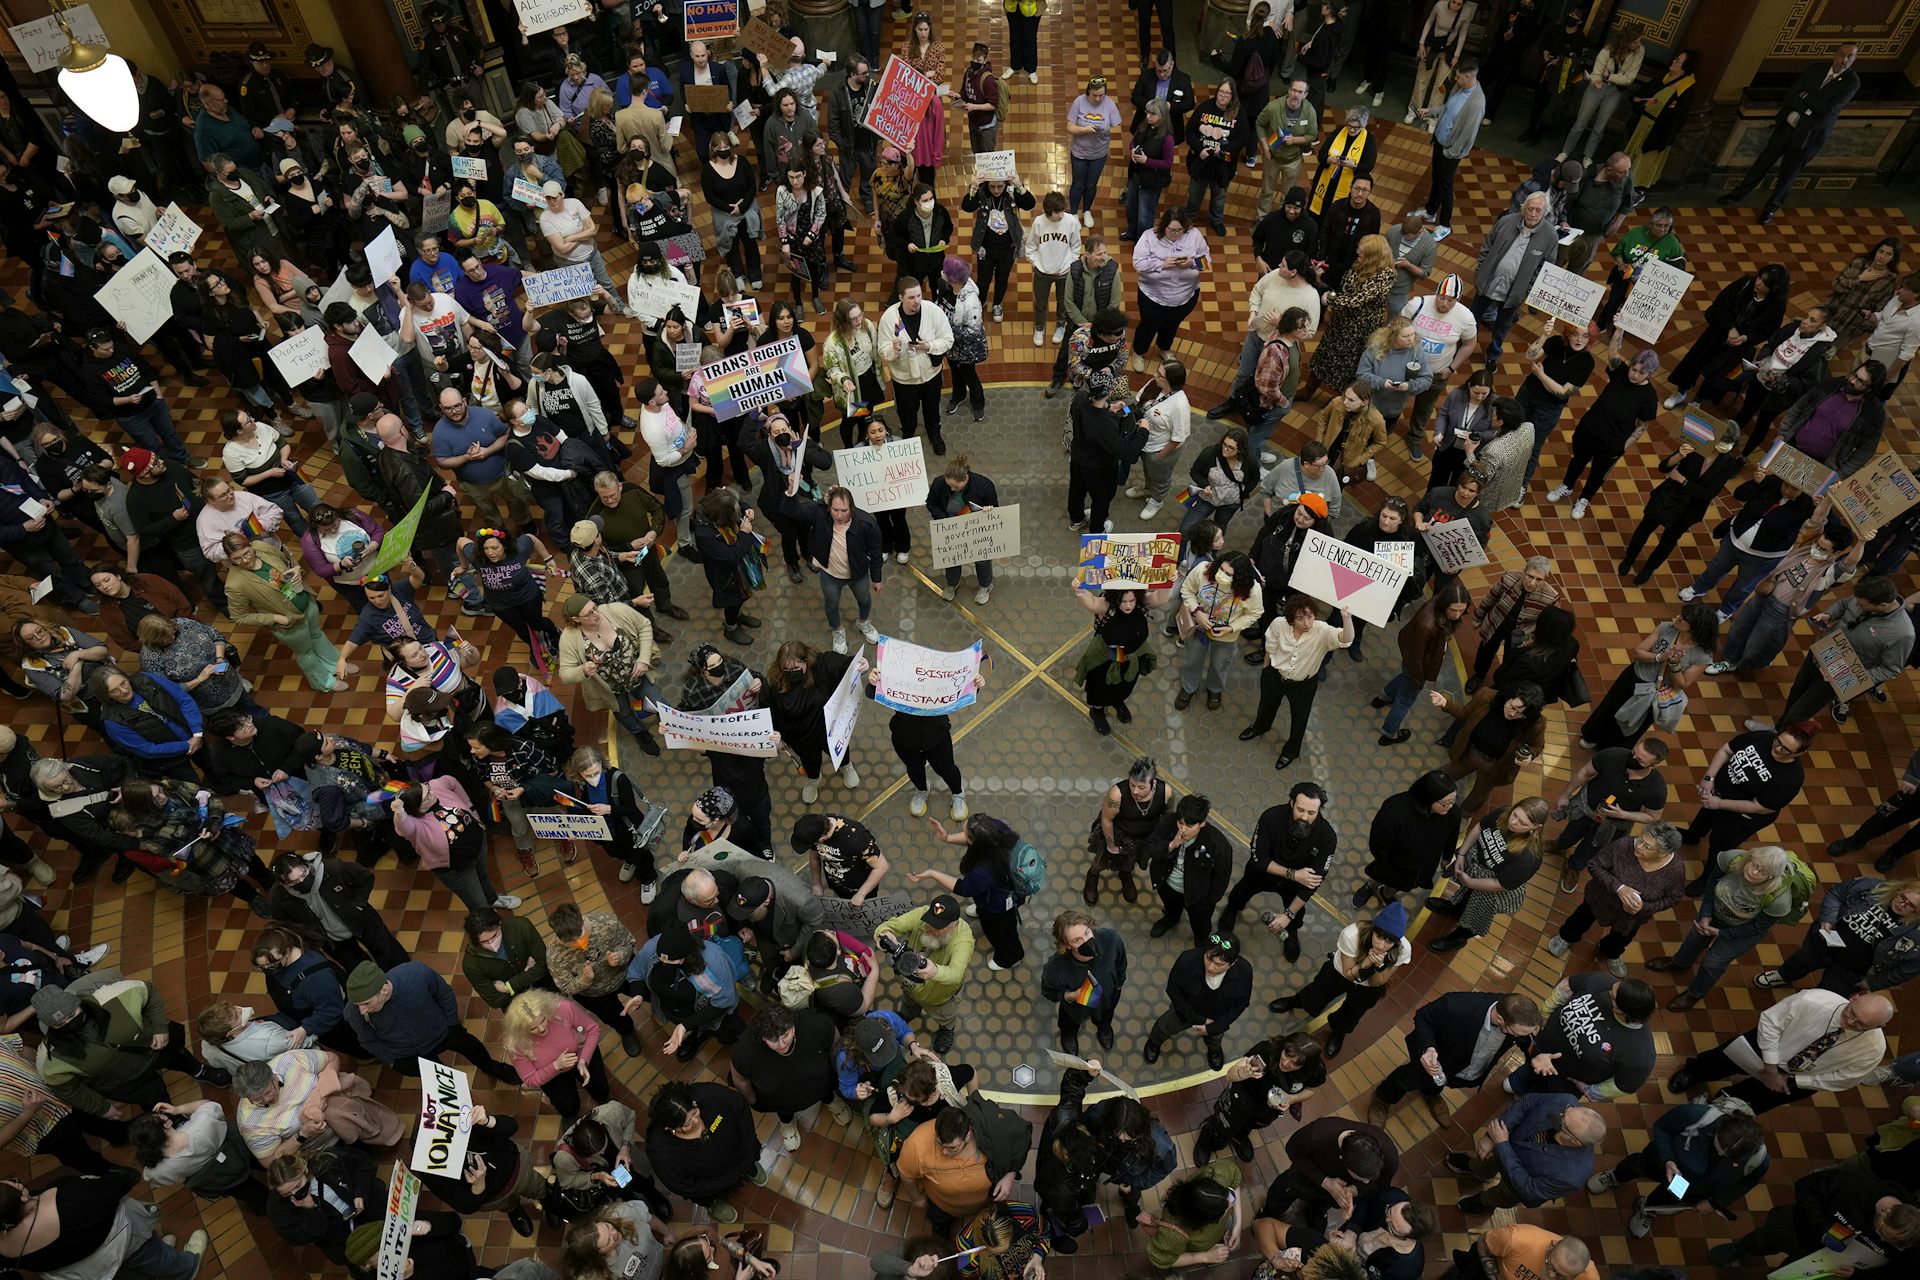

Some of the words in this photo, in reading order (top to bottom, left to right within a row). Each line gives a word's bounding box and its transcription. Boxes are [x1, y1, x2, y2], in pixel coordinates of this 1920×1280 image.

[520, 0, 541, 12] ALL
[687, 6, 704, 16] NO
[707, 3, 737, 14] HATE
[696, 26, 710, 34] OUR
[712, 24, 737, 32] STATE
[894, 63, 930, 97] TRANS
[887, 93, 906, 112] ARE
[890, 77, 925, 111] RIGHTS
[876, 101, 915, 135] HUMAN
[453, 157, 460, 166] NO
[462, 158, 476, 168] HATE
[469, 168, 485, 178] STATE
[641, 223, 657, 231] GENDER
[657, 218, 667, 226] NOT
[1039, 232, 1069, 245] IOWA
[1630, 248, 1659, 260] POWER
[525, 275, 541, 287] OUR
[541, 266, 582, 285] LIBERTIES
[582, 265, 590, 274] WE
[1562, 271, 1580, 285] OUR
[1649, 262, 1679, 285] TRANS
[527, 283, 551, 296] PRIZE
[564, 278, 575, 287] OUR
[679, 293, 695, 302] THEY
[1542, 275, 1590, 303] EXISTENCE
[1639, 275, 1682, 301] EXISTENCE
[1650, 291, 1658, 300] IS
[533, 297, 546, 307] WE
[548, 290, 565, 303] WILL
[1536, 289, 1581, 316] RESISTANCE
[1631, 289, 1660, 309] ROOTED
[1660, 303, 1670, 312] IN
[1631, 298, 1656, 316] HUMAN
[1415, 314, 1453, 336] HERE
[1624, 305, 1654, 325] HISTORY
[270, 336, 310, 362] Protect
[702, 354, 750, 381] TRANS
[753, 339, 798, 363] RIGHTS
[102, 357, 133, 382] HUMAN
[745, 366, 761, 377] ARE
[551, 389, 560, 397] ARE
[729, 370, 786, 400] HUMAN
[544, 403, 570, 412] WAITING
[740, 388, 785, 412] RIGHTS
[839, 450, 884, 468] TRANS
[886, 440, 921, 461] PEOPLE
[844, 471, 879, 489] WILL
[884, 460, 923, 481] ALWAYS
[1869, 471, 1885, 485] WE
[1877, 451, 1895, 472] OUR
[1889, 468, 1920, 501] LIBERTIES
[865, 484, 914, 506] EXIST!!!
[1848, 480, 1869, 507] RIGHTS
[1862, 500, 1875, 512] WE
[932, 519, 960, 535] There
[963, 517, 982, 530] goes
[986, 512, 1000, 523] the
[943, 521, 1005, 546] government
[934, 541, 970, 560] taking
[972, 535, 994, 550] away
[942, 548, 974, 567] rights
[976, 545, 1007, 560] again!
[1149, 539, 1174, 555] PRIZE
[1376, 542, 1392, 552] THIS
[1392, 542, 1399, 551] IS
[1400, 543, 1414, 552] WHY
[1435, 543, 1455, 569] WRONG
[495, 561, 522, 573] TRANS
[1307, 540, 1402, 592] SILENCE=DEATH
[1376, 553, 1406, 568] PRIDE
[482, 571, 512, 584] PEOPLE
[1819, 644, 1857, 694] NEIGHBOR
[1831, 632, 1852, 661] LOVE
[1846, 658, 1869, 685] YOUR
[915, 665, 969, 681] EXISTENCE
[916, 675, 927, 684] or
[886, 686, 962, 707] RESISTANCE!
[661, 704, 703, 724] TRANS
[710, 712, 761, 725] PEOPLE
[667, 732, 756, 751] TRANSPHOBIA
[757, 740, 775, 750] IS
[708, 728, 772, 739] DANGEROUS
[1729, 753, 1749, 783] STUFF
[1735, 749, 1753, 770] GET
[1744, 744, 1772, 783] BITCHES
[529, 815, 564, 825] TRANS
[566, 815, 597, 825] RIGHTS
[536, 829, 570, 839] HUMAN
[572, 828, 605, 840] RIGHTS!
[1492, 828, 1508, 853] QUEER
[1482, 827, 1505, 865] LIBERATION
[839, 908, 865, 920] NOT
[1851, 913, 1884, 938] STUFF
[1562, 1001, 1586, 1036] TAKE
[1579, 993, 1605, 1023] ALLY
[1571, 997, 1601, 1045] MEANS
[435, 1063, 456, 1108] NICE
[423, 1092, 438, 1130] NOT
[427, 1107, 461, 1171] IOWA
[390, 1162, 406, 1216] HELL?
[400, 1173, 415, 1224] IOWA
[1831, 1210, 1847, 1224] you
[385, 1213, 398, 1251] THIS
[394, 1224, 408, 1261] IT'S
[379, 1253, 392, 1280] IS
